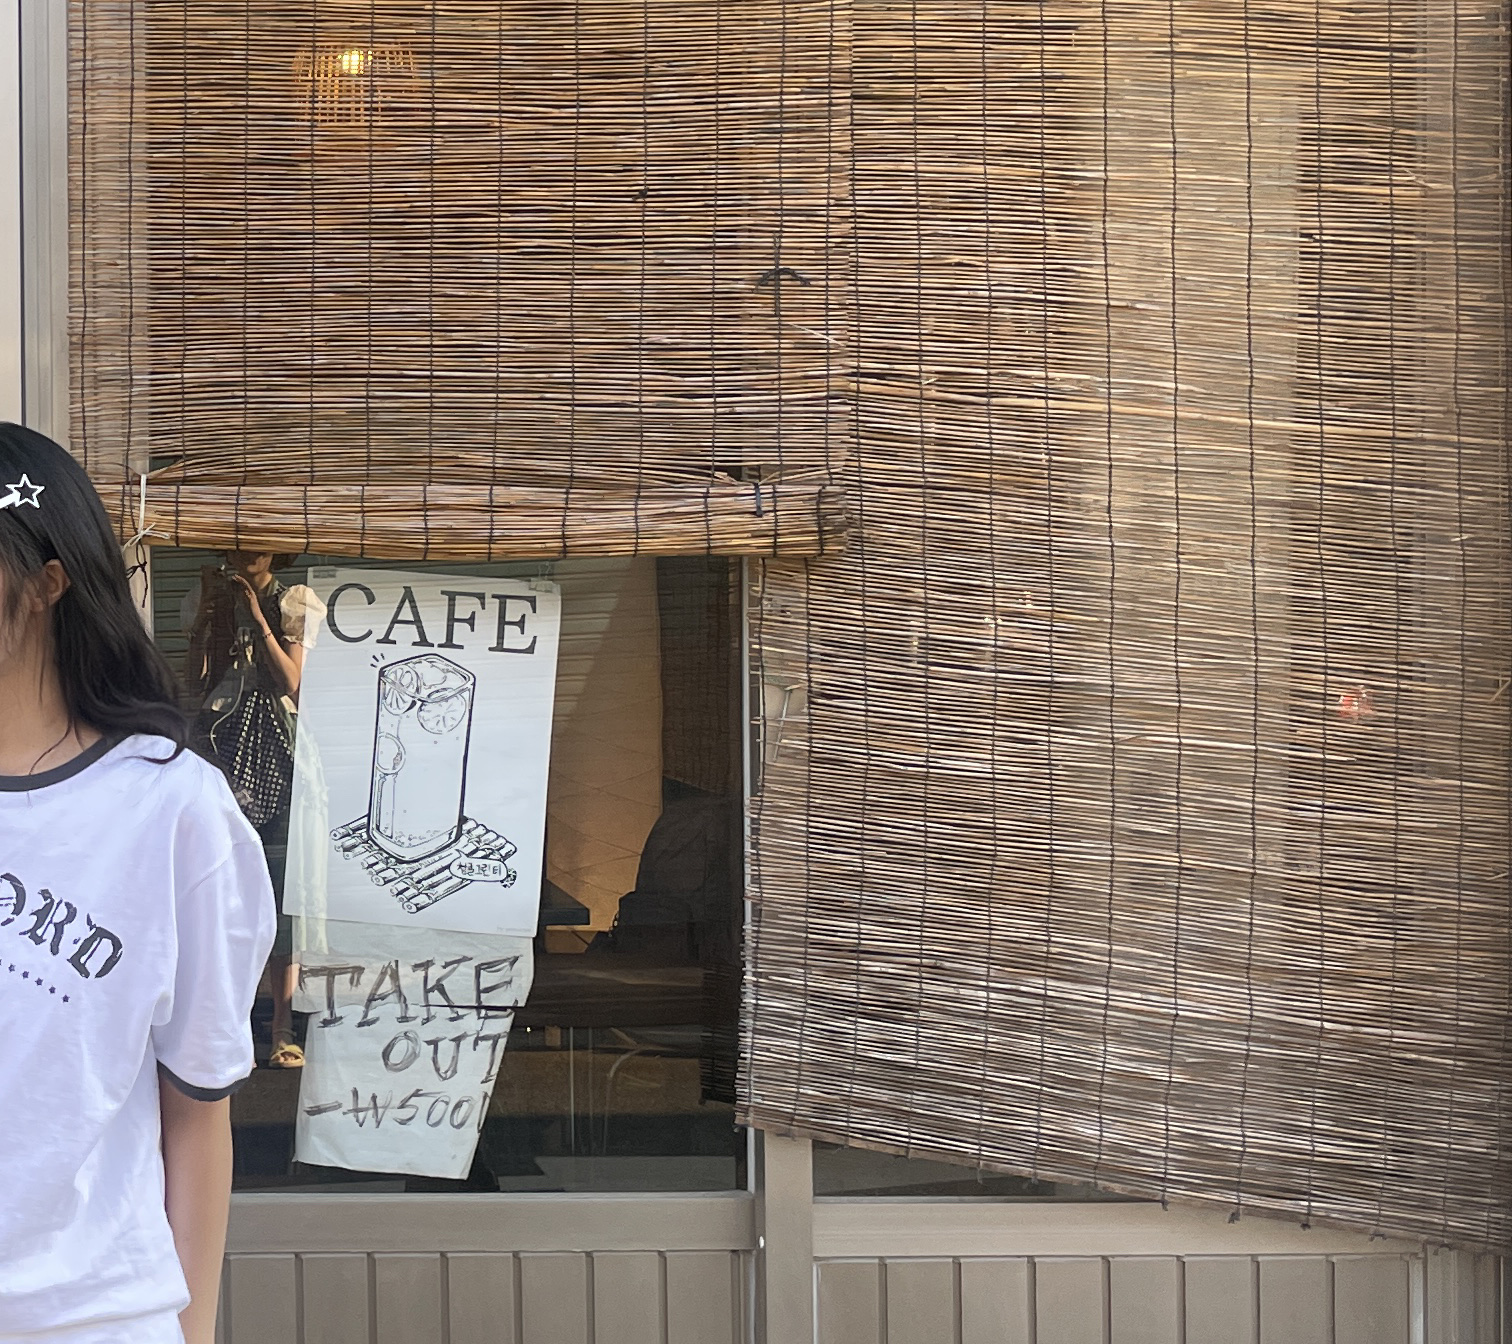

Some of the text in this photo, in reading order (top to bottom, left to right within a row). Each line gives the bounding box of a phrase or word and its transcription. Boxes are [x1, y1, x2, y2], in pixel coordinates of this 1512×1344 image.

[325, 582, 539, 655] CAFE
[299, 955, 523, 1029] TAKE
[382, 1029, 509, 1085] OUT
